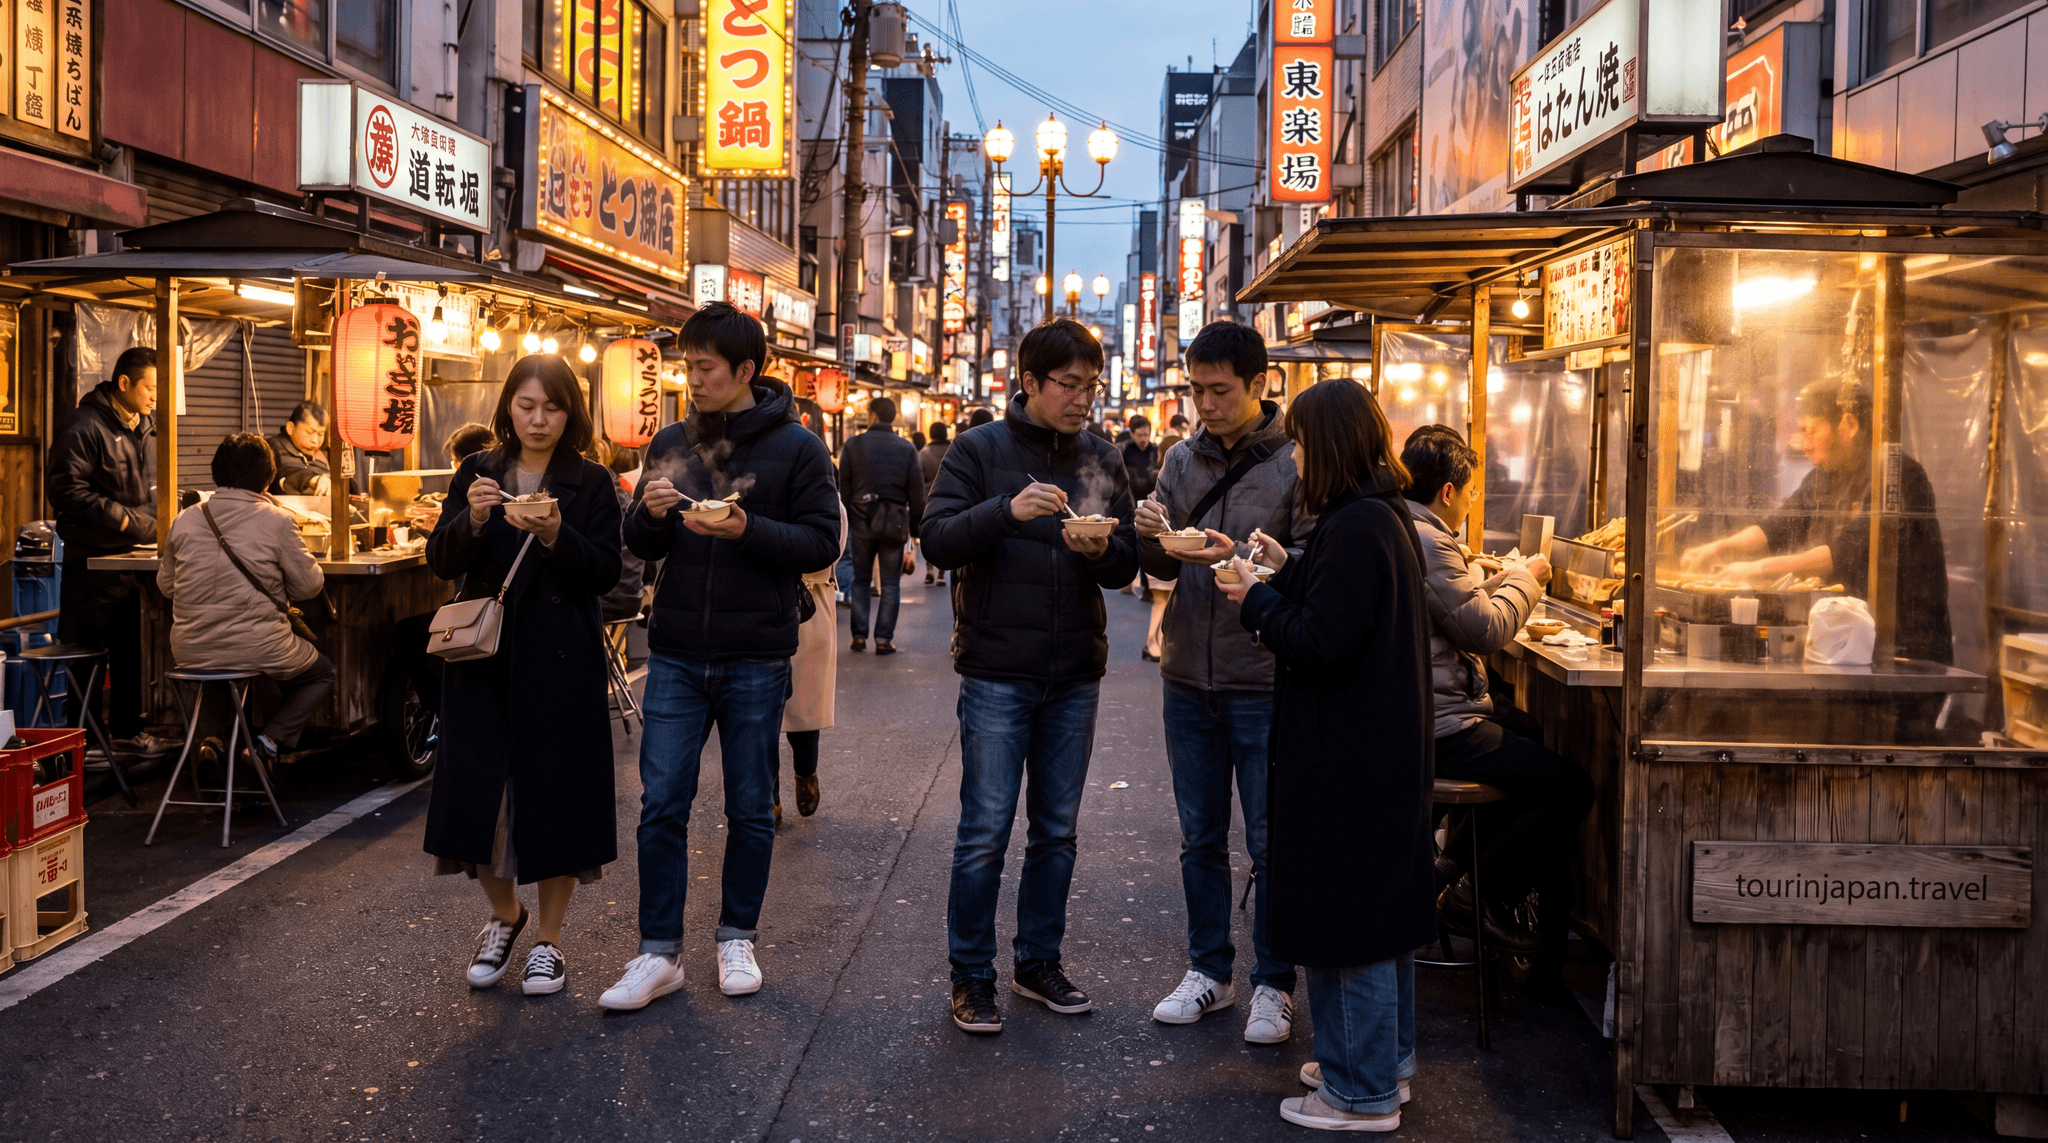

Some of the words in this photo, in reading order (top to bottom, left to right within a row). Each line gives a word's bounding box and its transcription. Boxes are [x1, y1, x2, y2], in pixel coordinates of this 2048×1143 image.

[718, 0, 771, 148] とつ鍋
[1282, 61, 1321, 190] 東楽場
[1537, 41, 1619, 153] はたん焼
[408, 148, 479, 218] 道転堀
[1735, 873, 1988, 906] tourinjapan.travel
